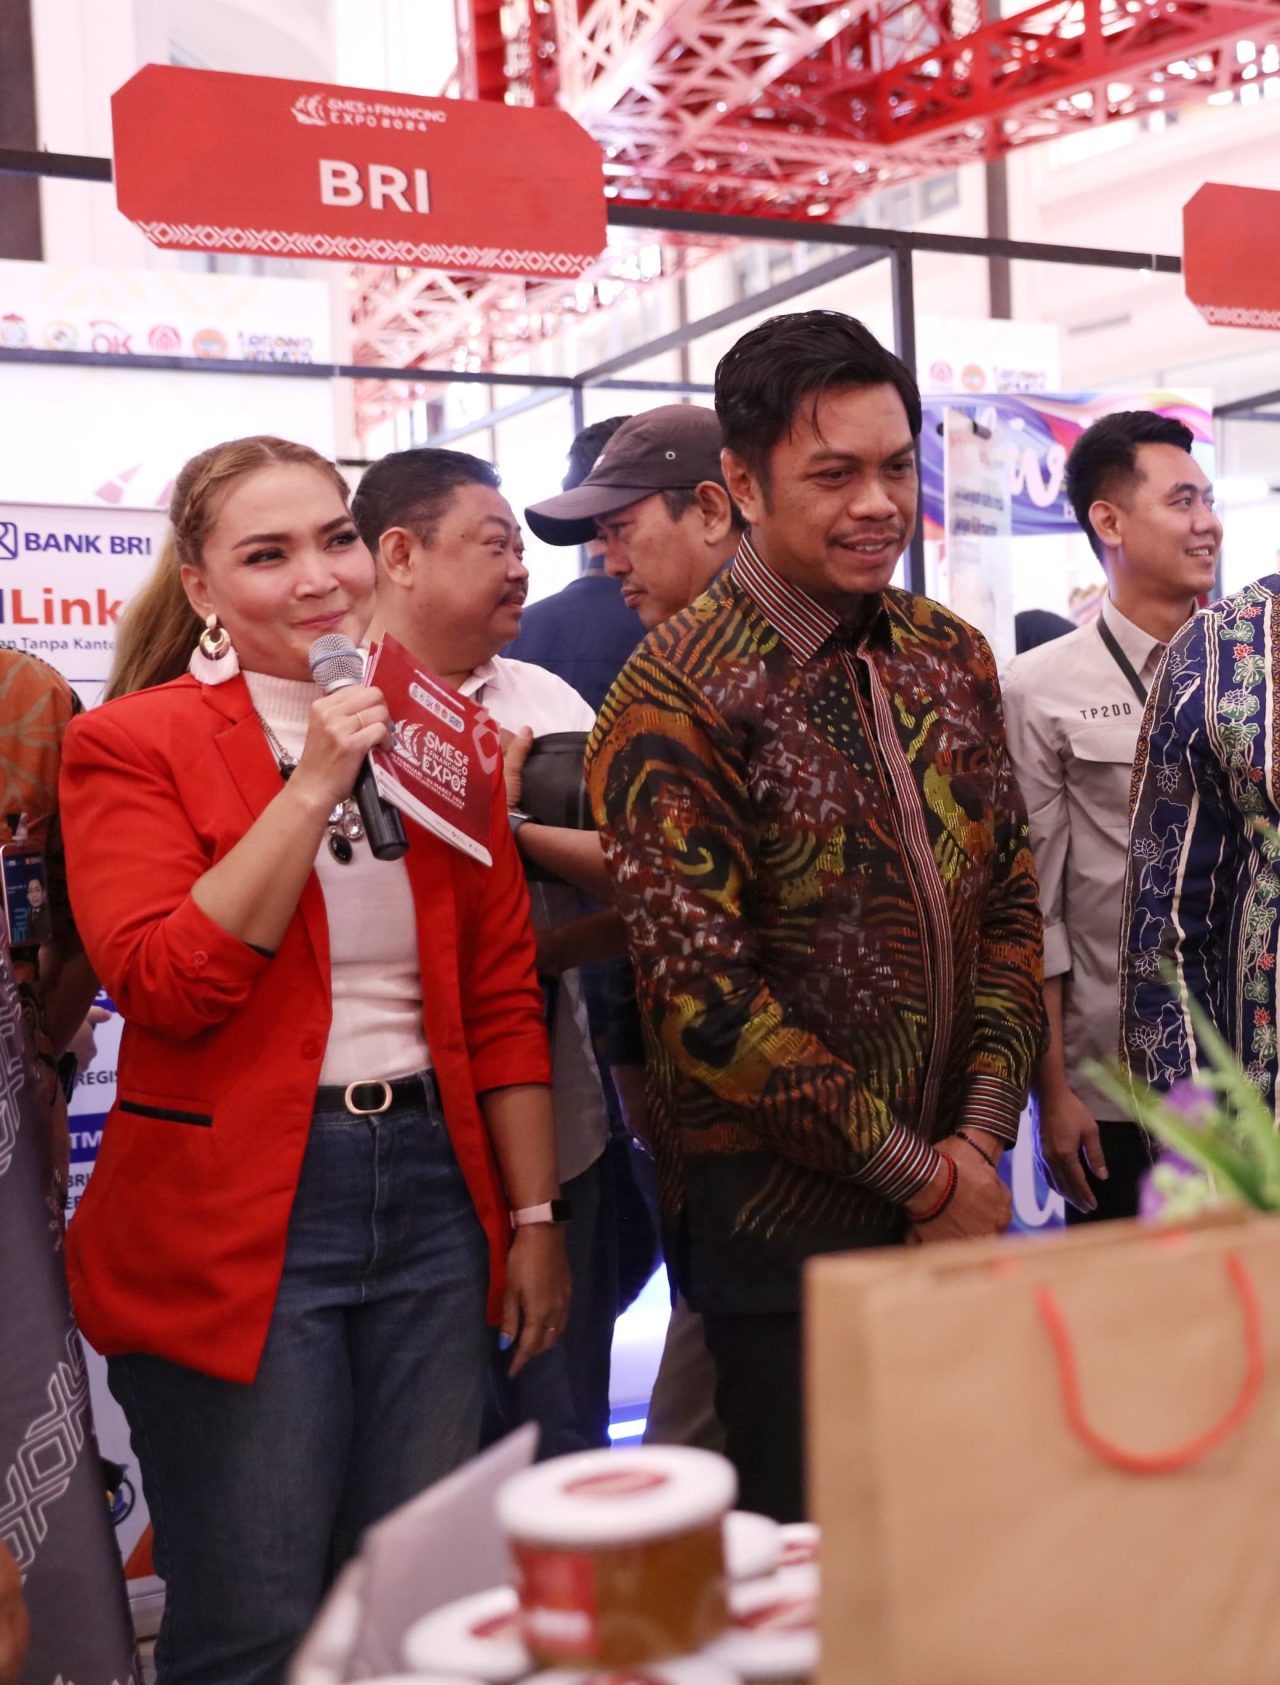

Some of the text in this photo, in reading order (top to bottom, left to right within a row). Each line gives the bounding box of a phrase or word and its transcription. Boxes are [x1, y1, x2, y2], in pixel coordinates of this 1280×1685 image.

[330, 111, 377, 127] EXPO
[374, 104, 448, 123] FINANCING
[319, 158, 430, 214] BRI
[24, 532, 153, 556] BANK BRI
[20, 637, 69, 651] Tanpa
[424, 731, 463, 767] SMES
[422, 754, 461, 792] EXPO
[429, 749, 462, 776] FINANCING
